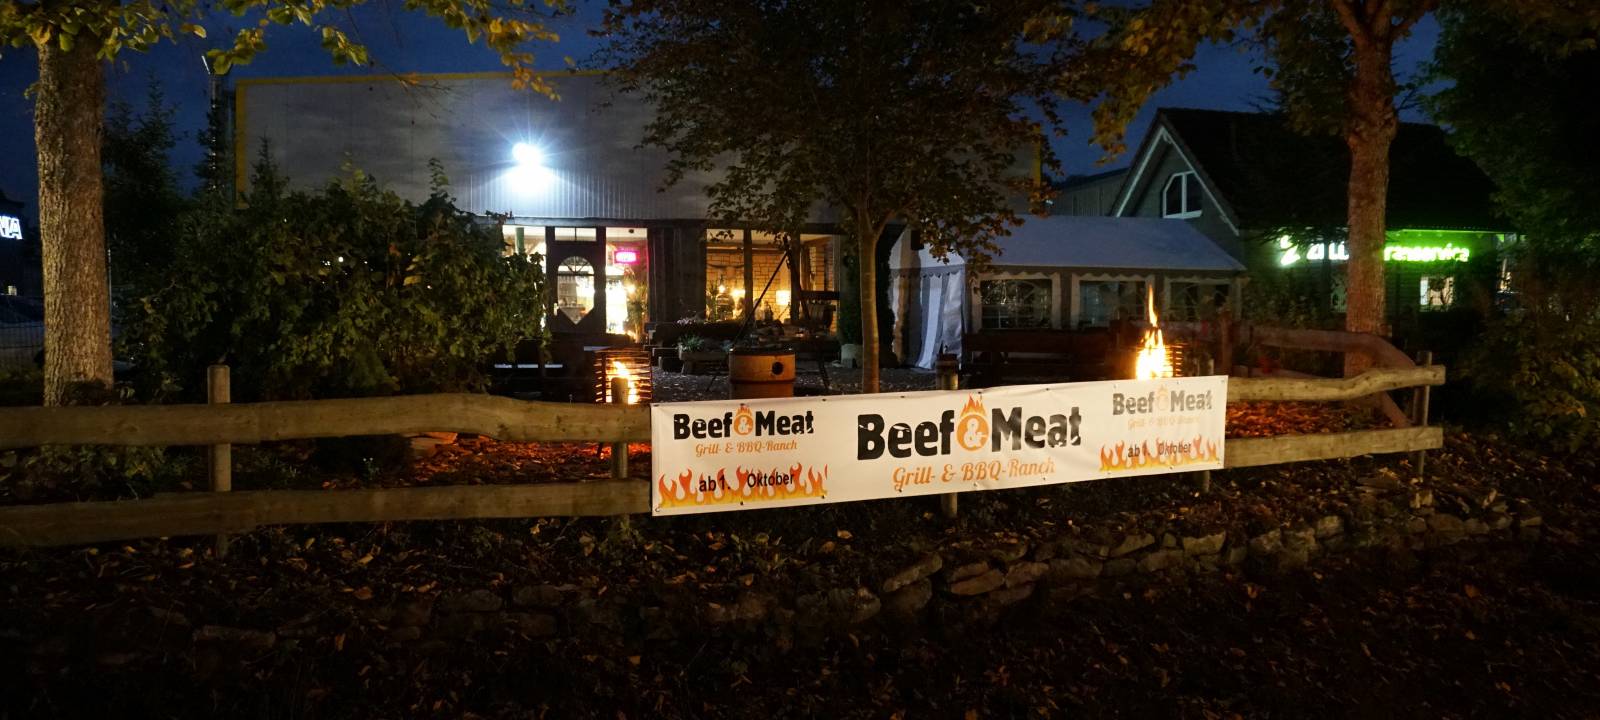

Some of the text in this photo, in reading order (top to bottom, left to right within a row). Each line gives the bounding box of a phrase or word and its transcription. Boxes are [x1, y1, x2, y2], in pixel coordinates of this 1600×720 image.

[1112, 391, 1155, 416] Beef
[1170, 389, 1213, 412] Meat
[673, 411, 733, 440] Beef
[755, 410, 814, 437] Meat
[857, 409, 955, 460] Beef
[991, 406, 1082, 453] Meat
[725, 442, 734, 453] &
[736, 439, 797, 453] BBQ-Ranch
[1159, 441, 1192, 456] Oktober
[699, 475, 717, 492] ab
[746, 472, 795, 488] Oktober
[893, 457, 1056, 492] Grill- & BBQ-Ranch
